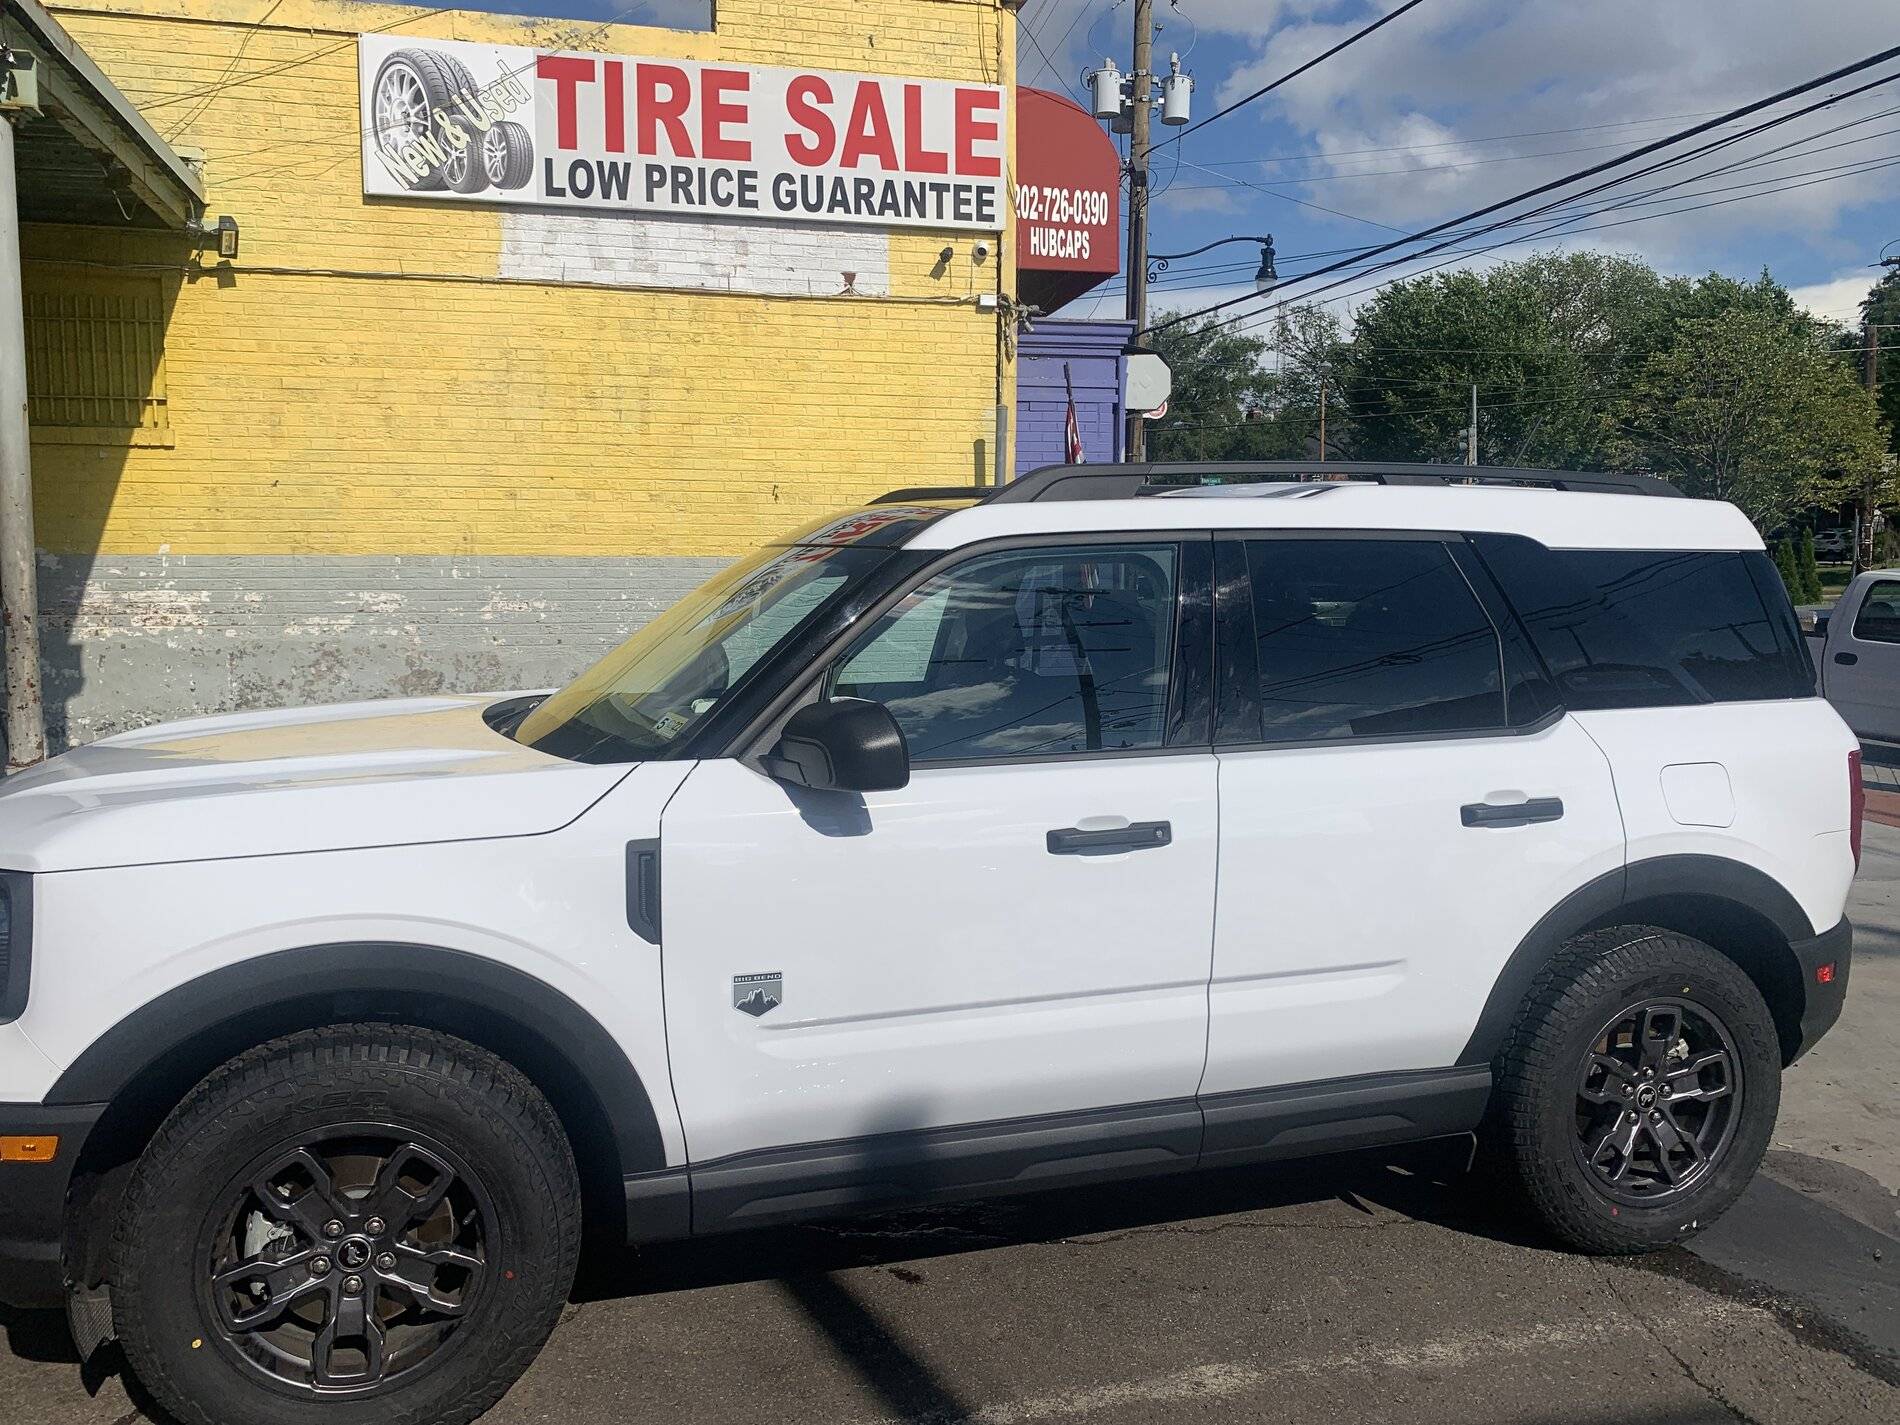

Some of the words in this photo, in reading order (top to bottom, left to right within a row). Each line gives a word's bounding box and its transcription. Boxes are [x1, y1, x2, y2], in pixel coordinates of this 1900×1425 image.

[452, 60, 531, 131] Used
[537, 55, 752, 161] TIRE
[785, 76, 1000, 177] SALE
[434, 108, 471, 149] &
[375, 130, 447, 191] New
[545, 157, 631, 201] LOW
[645, 163, 758, 209] PRICE
[773, 172, 995, 222] GUARANTEE
[1030, 226, 1090, 260] HUBCAPS
